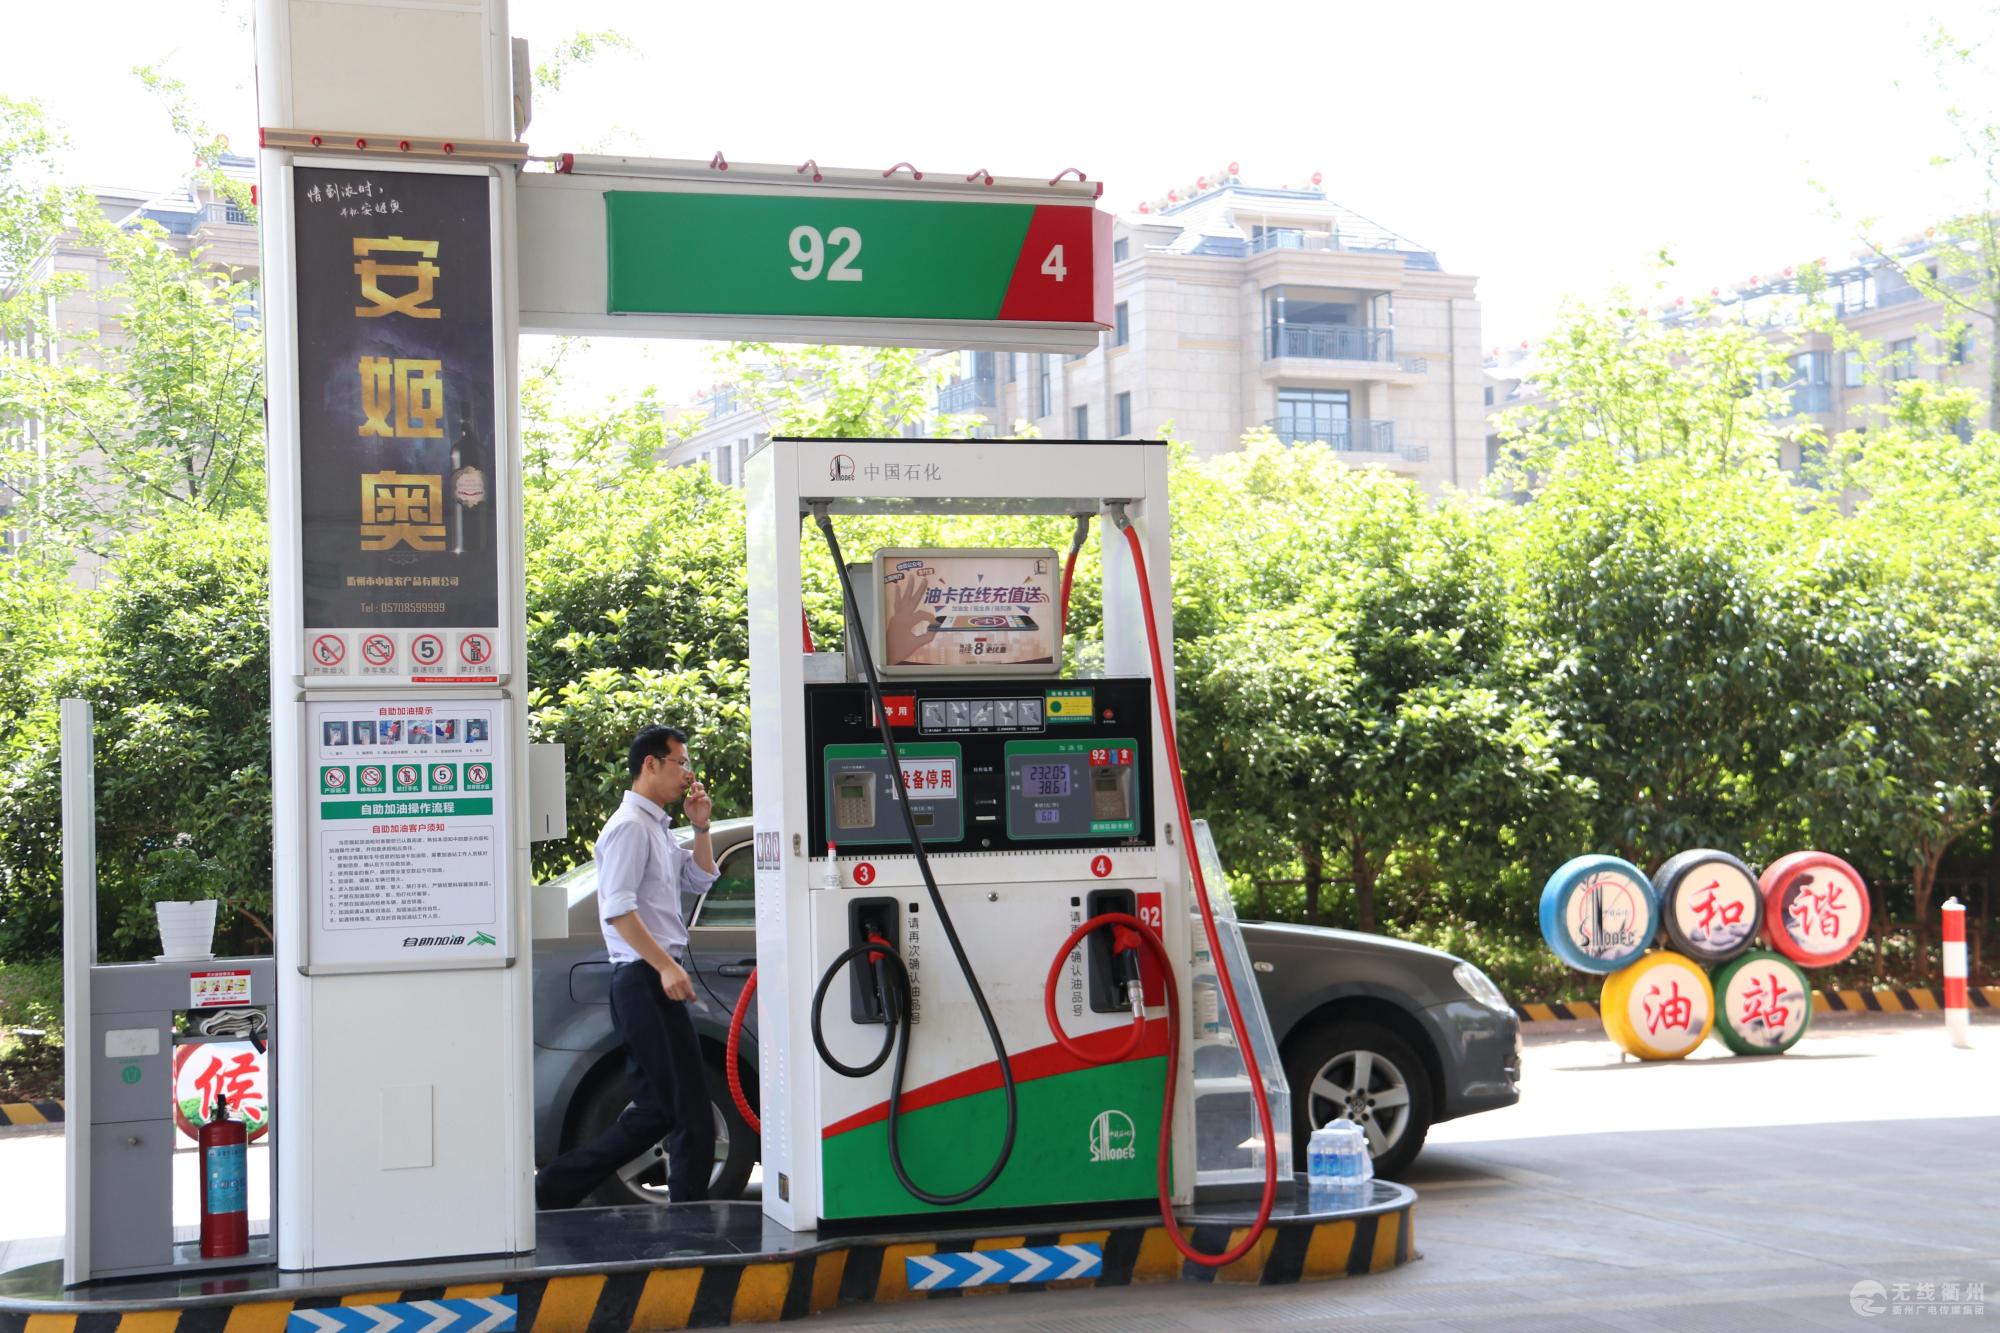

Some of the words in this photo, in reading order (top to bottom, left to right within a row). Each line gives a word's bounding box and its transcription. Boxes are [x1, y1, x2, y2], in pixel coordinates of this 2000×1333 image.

[788, 225, 863, 282] 92
[1040, 244, 1068, 282] 4
[864, 462, 942, 481] 中国石化
[923, 586, 1042, 604] 油卡在线充值送
[421, 640, 435, 658] 5
[378, 706, 434, 717] 自助加油提示
[884, 706, 908, 717] 停用
[1091, 749, 1106, 760] 92
[439, 769, 447, 781] 5
[900, 769, 952, 790] 设备停用
[1030, 765, 1067, 781] 232.05
[361, 801, 456, 816] 自助加油操作流程
[371, 823, 446, 835] 自助加油客户须知
[859, 865, 870, 883] 3
[1096, 858, 1107, 875] 4
[1139, 906, 1161, 928] 92
[402, 934, 466, 948] 自助加油
[194, 1052, 265, 1123] 候
